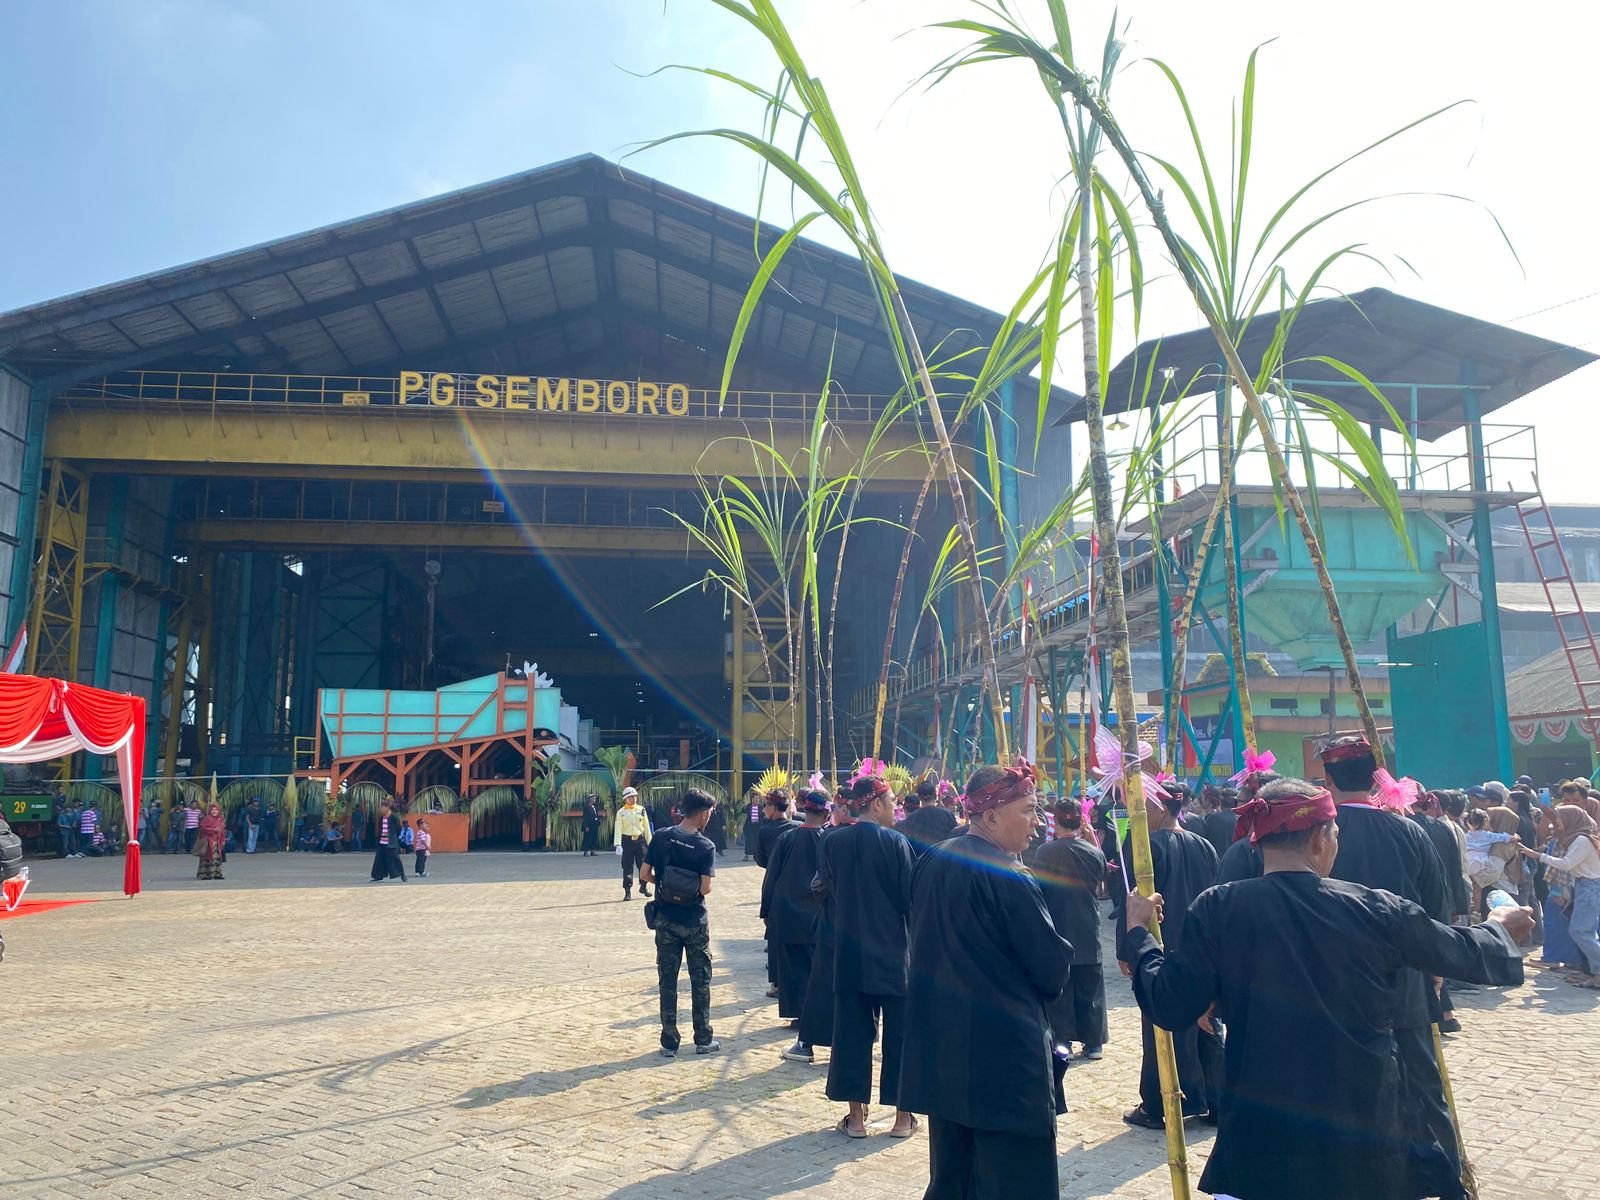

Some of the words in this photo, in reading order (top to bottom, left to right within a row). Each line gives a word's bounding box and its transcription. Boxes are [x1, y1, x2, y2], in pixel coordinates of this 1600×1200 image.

[399, 370, 456, 407] PG
[475, 374, 690, 417] SEMBORO
[14, 801, 26, 814] 29
